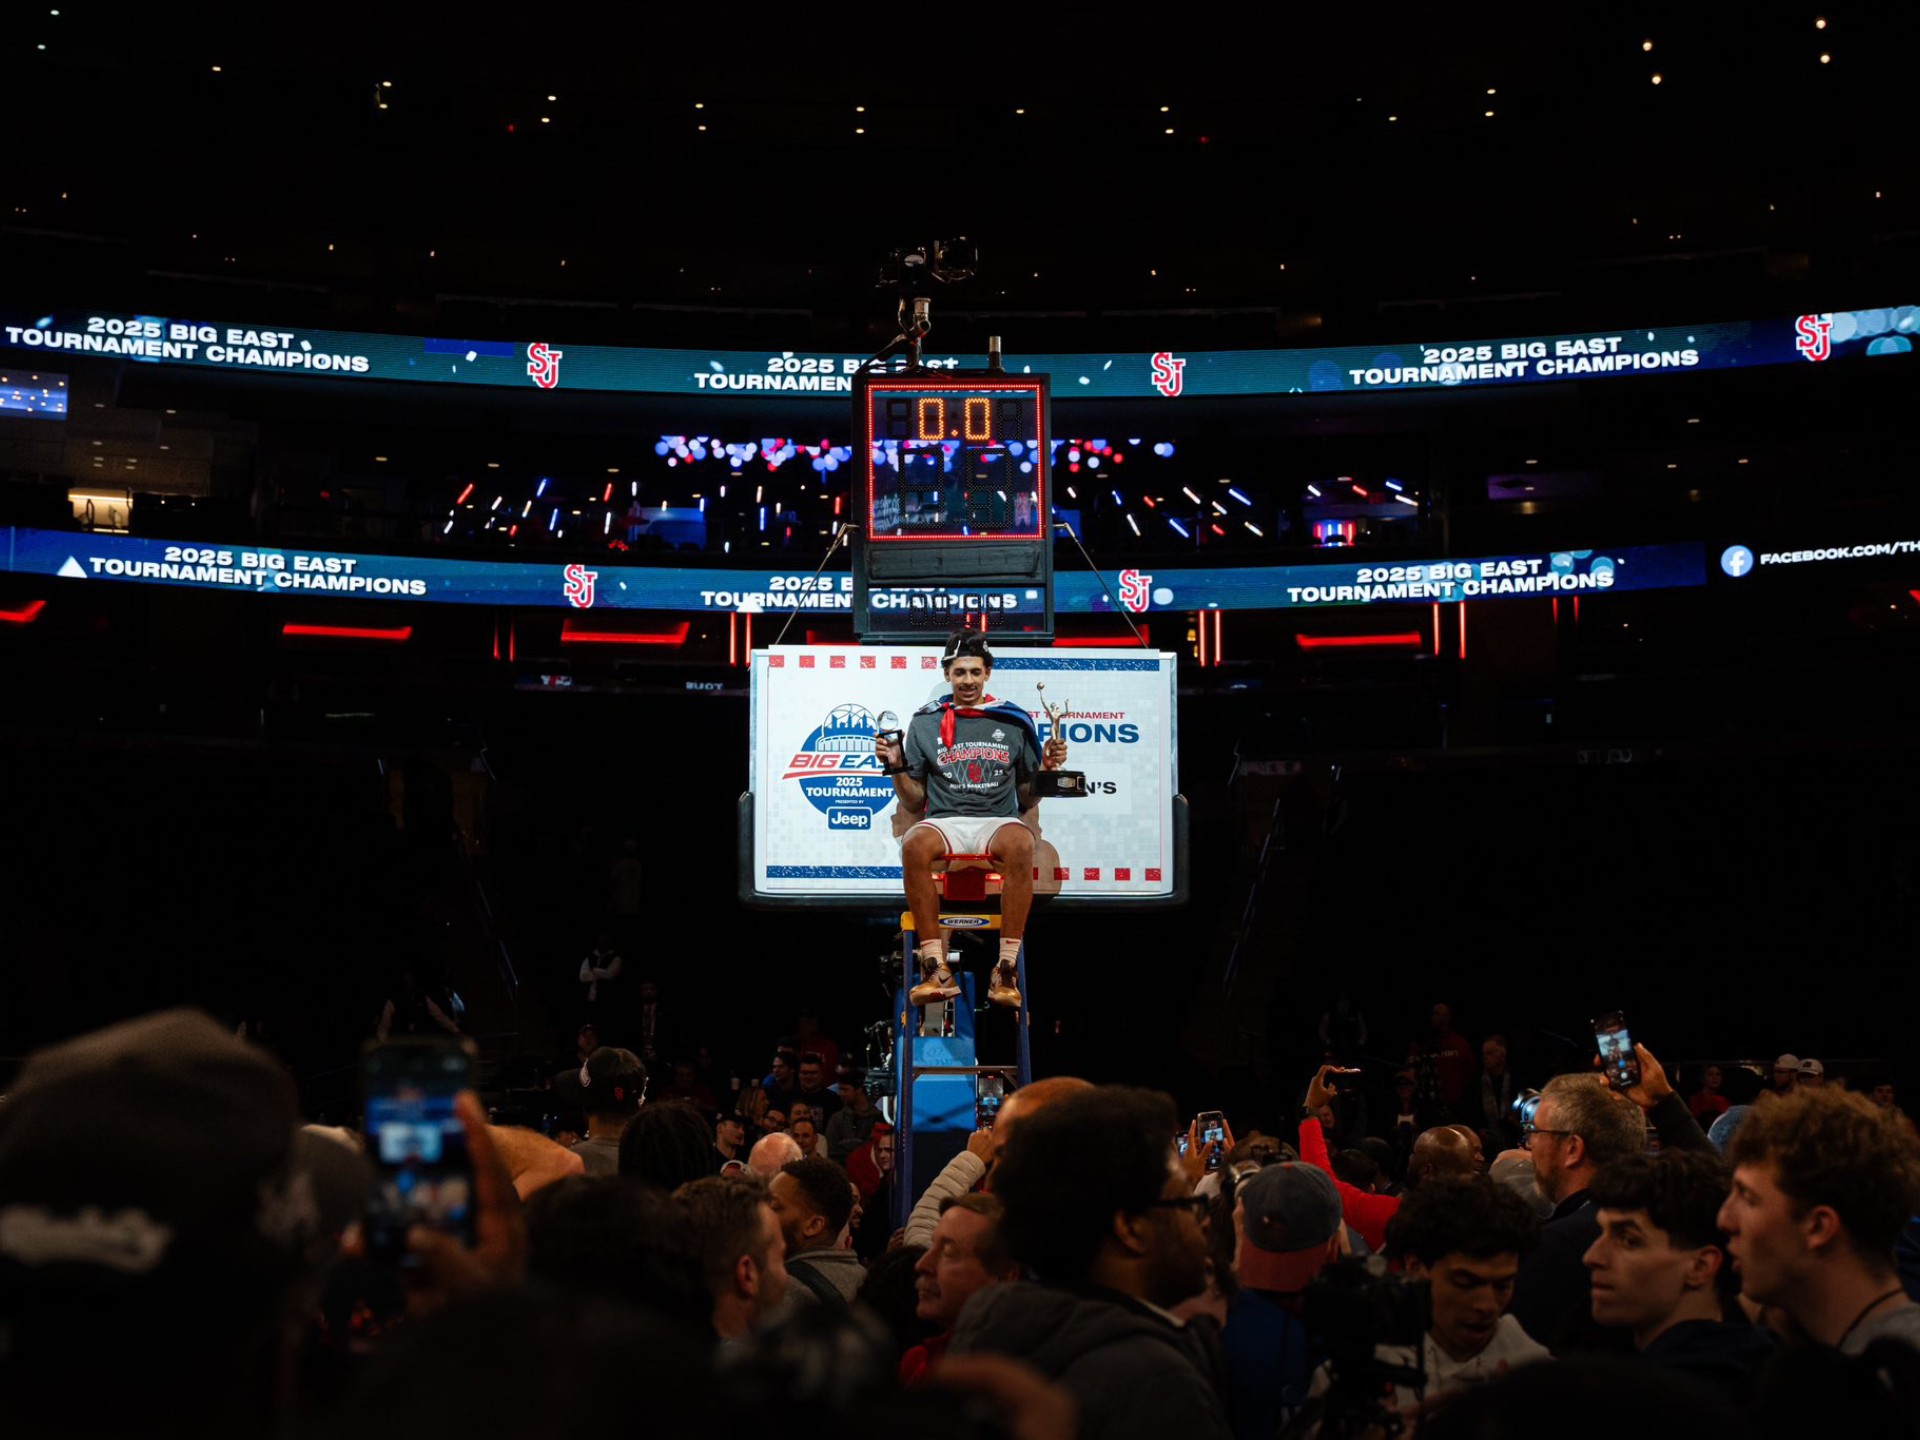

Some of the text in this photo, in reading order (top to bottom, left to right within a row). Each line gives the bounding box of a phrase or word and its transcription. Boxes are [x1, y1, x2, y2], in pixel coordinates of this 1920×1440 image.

[88, 317, 294, 349] 2025 BIG EAST
[6, 327, 369, 372] TOURNAMENT CHAMPIONS
[1424, 337, 1622, 364] 2025 BIG EAST
[767, 358, 835, 373] 2025
[1349, 349, 1699, 385] TOURNAMENT CHAMPIONS
[694, 373, 852, 391] TOURNAMEN
[919, 398, 990, 440] 0.0
[165, 547, 356, 574] 2025 BIG EAST
[89, 557, 426, 595] TOURNAMENT CHAMPIONS
[1357, 559, 1542, 583] 2025 BIG EAST
[769, 577, 833, 591] 2025
[1288, 572, 1614, 602] TOURNAMENT CHAMPIONS
[701, 591, 1017, 609] TOURNAMEN CHAMPIONS
[1037, 723, 1139, 743] PIONS
[789, 754, 885, 768] BIG EA
[937, 748, 1009, 765] CHAMPIONS
[836, 777, 863, 787] 2025
[806, 787, 894, 798] TOURNAMENT
[831, 812, 868, 827] Jeep
